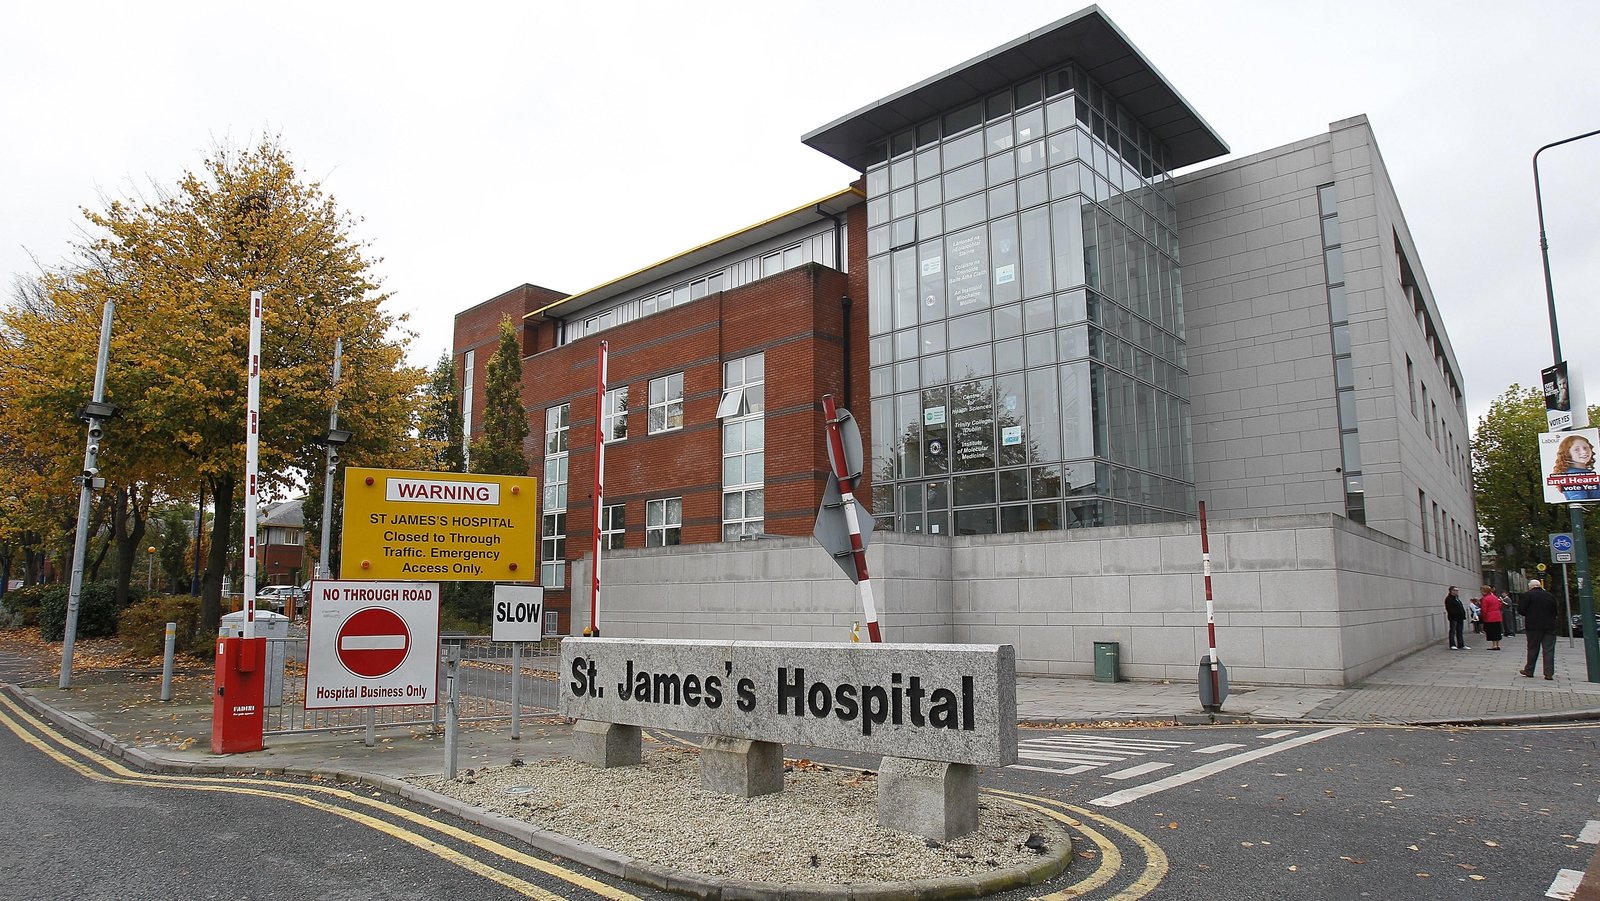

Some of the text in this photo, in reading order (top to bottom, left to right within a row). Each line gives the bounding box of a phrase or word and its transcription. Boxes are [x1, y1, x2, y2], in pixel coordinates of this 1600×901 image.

[969, 404, 992, 412] Sciences
[955, 418, 993, 428] Trinity College
[1549, 417, 1560, 426] VOTE
[961, 452, 985, 460] Medicine
[963, 445, 989, 453] Molecular
[1548, 477, 1566, 485] and
[1569, 475, 1600, 484] Heard
[398, 483, 490, 501] WARNING
[370, 513, 514, 528] ST JAMES'S HOSPITAL
[383, 530, 501, 546] Closed to Through
[383, 546, 500, 561] Traffic. Emergency
[402, 562, 484, 576] Access Only.
[323, 588, 432, 601] NO THROUGH ROAD
[496, 601, 540, 623] SLOW
[316, 684, 427, 701] Hospital Business Only
[571, 656, 975, 736] St. James's Hospital
